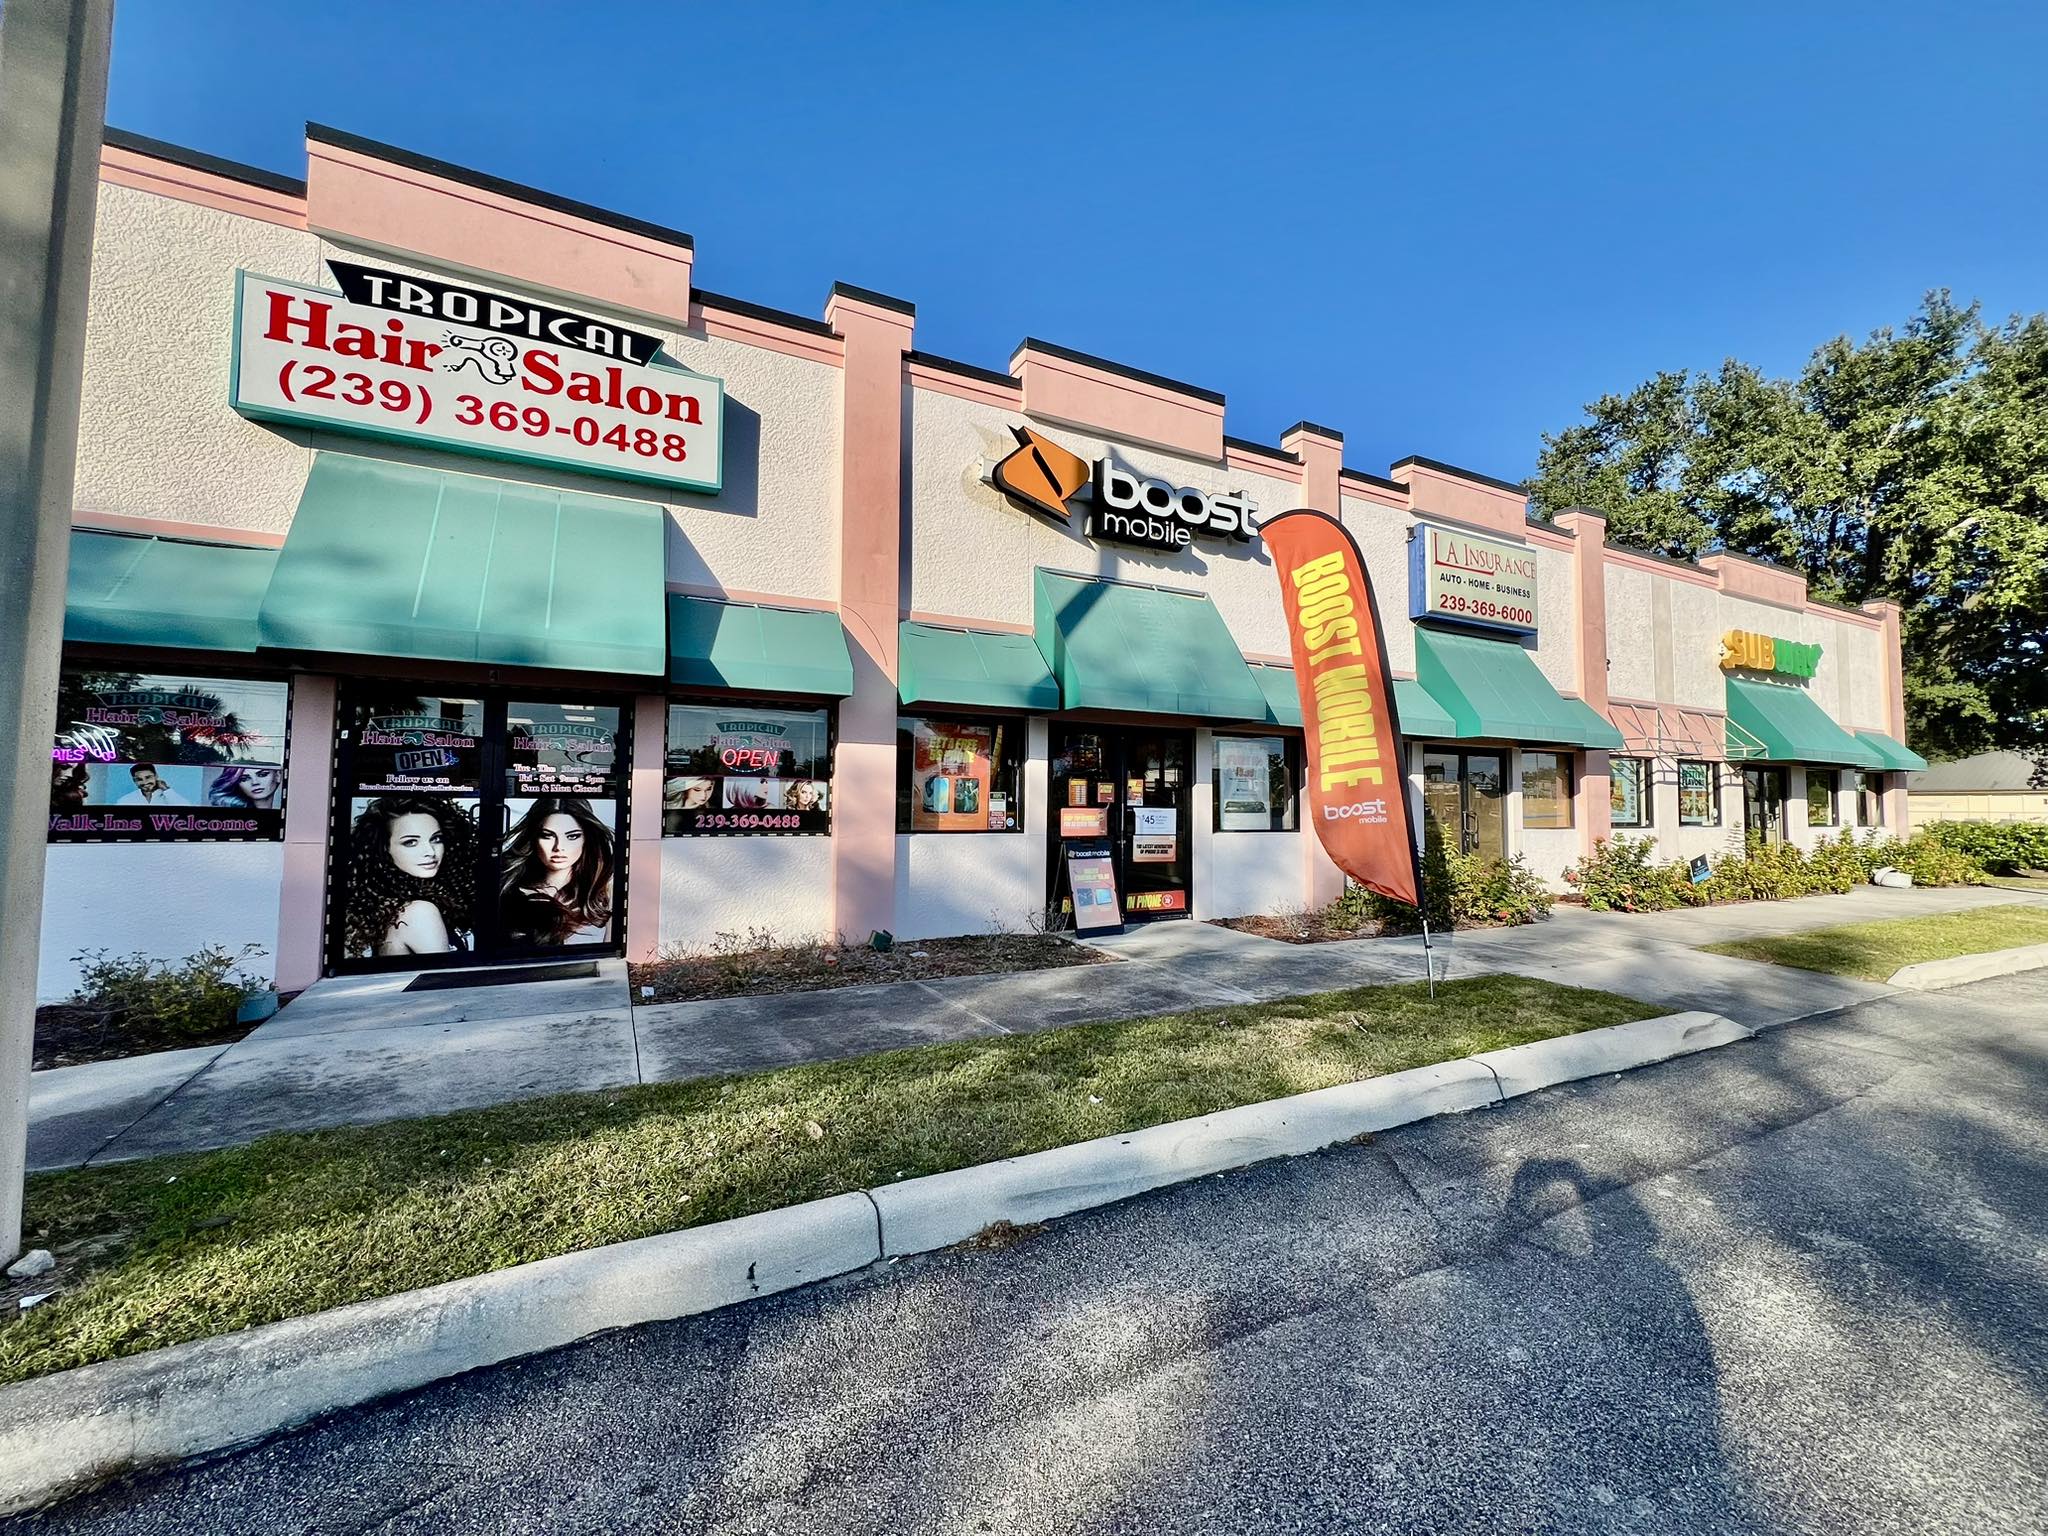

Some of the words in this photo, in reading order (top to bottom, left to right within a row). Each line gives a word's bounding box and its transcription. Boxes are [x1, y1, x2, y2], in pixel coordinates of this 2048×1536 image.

[363, 274, 643, 365] TROPICAL
[263, 290, 443, 373] Hair
[521, 349, 703, 426] Salon
[278, 359, 433, 425] (239)
[455, 394, 688, 463] 369-0488
[1101, 457, 1259, 538] boost
[1103, 512, 1191, 547] mobile
[1440, 572, 1462, 585] AUTO
[1468, 578, 1490, 590] HOME
[1496, 584, 1531, 599] BUSINESS
[1291, 550, 1363, 667] BOOST
[1439, 593, 1533, 624] 239-369-6000
[110, 692, 208, 709] TROPICAL
[86, 707, 139, 725] Hair
[161, 711, 226, 727] Salon
[382, 717, 463, 732] TROPICAL
[530, 724, 601, 738] TROPICAL
[722, 722, 781, 735] TROPICAL
[1312, 664, 1385, 792] MOBILE
[361, 731, 403, 747] Hair
[423, 734, 475, 748] Salon
[513, 737, 551, 750] Hair
[566, 738, 613, 753] Salon
[710, 735, 740, 746] Hair
[753, 735, 792, 749] Salon
[400, 750, 443, 769] OPEN
[721, 748, 780, 767] OPEN
[386, 774, 420, 783] Follow
[1324, 799, 1387, 820] boost
[149, 814, 258, 832] Welcome
[695, 814, 801, 829] 239-369-0488
[1358, 815, 1388, 824] mobile
[1092, 849, 1111, 857] mobile
[1136, 894, 1163, 909] PHONE
